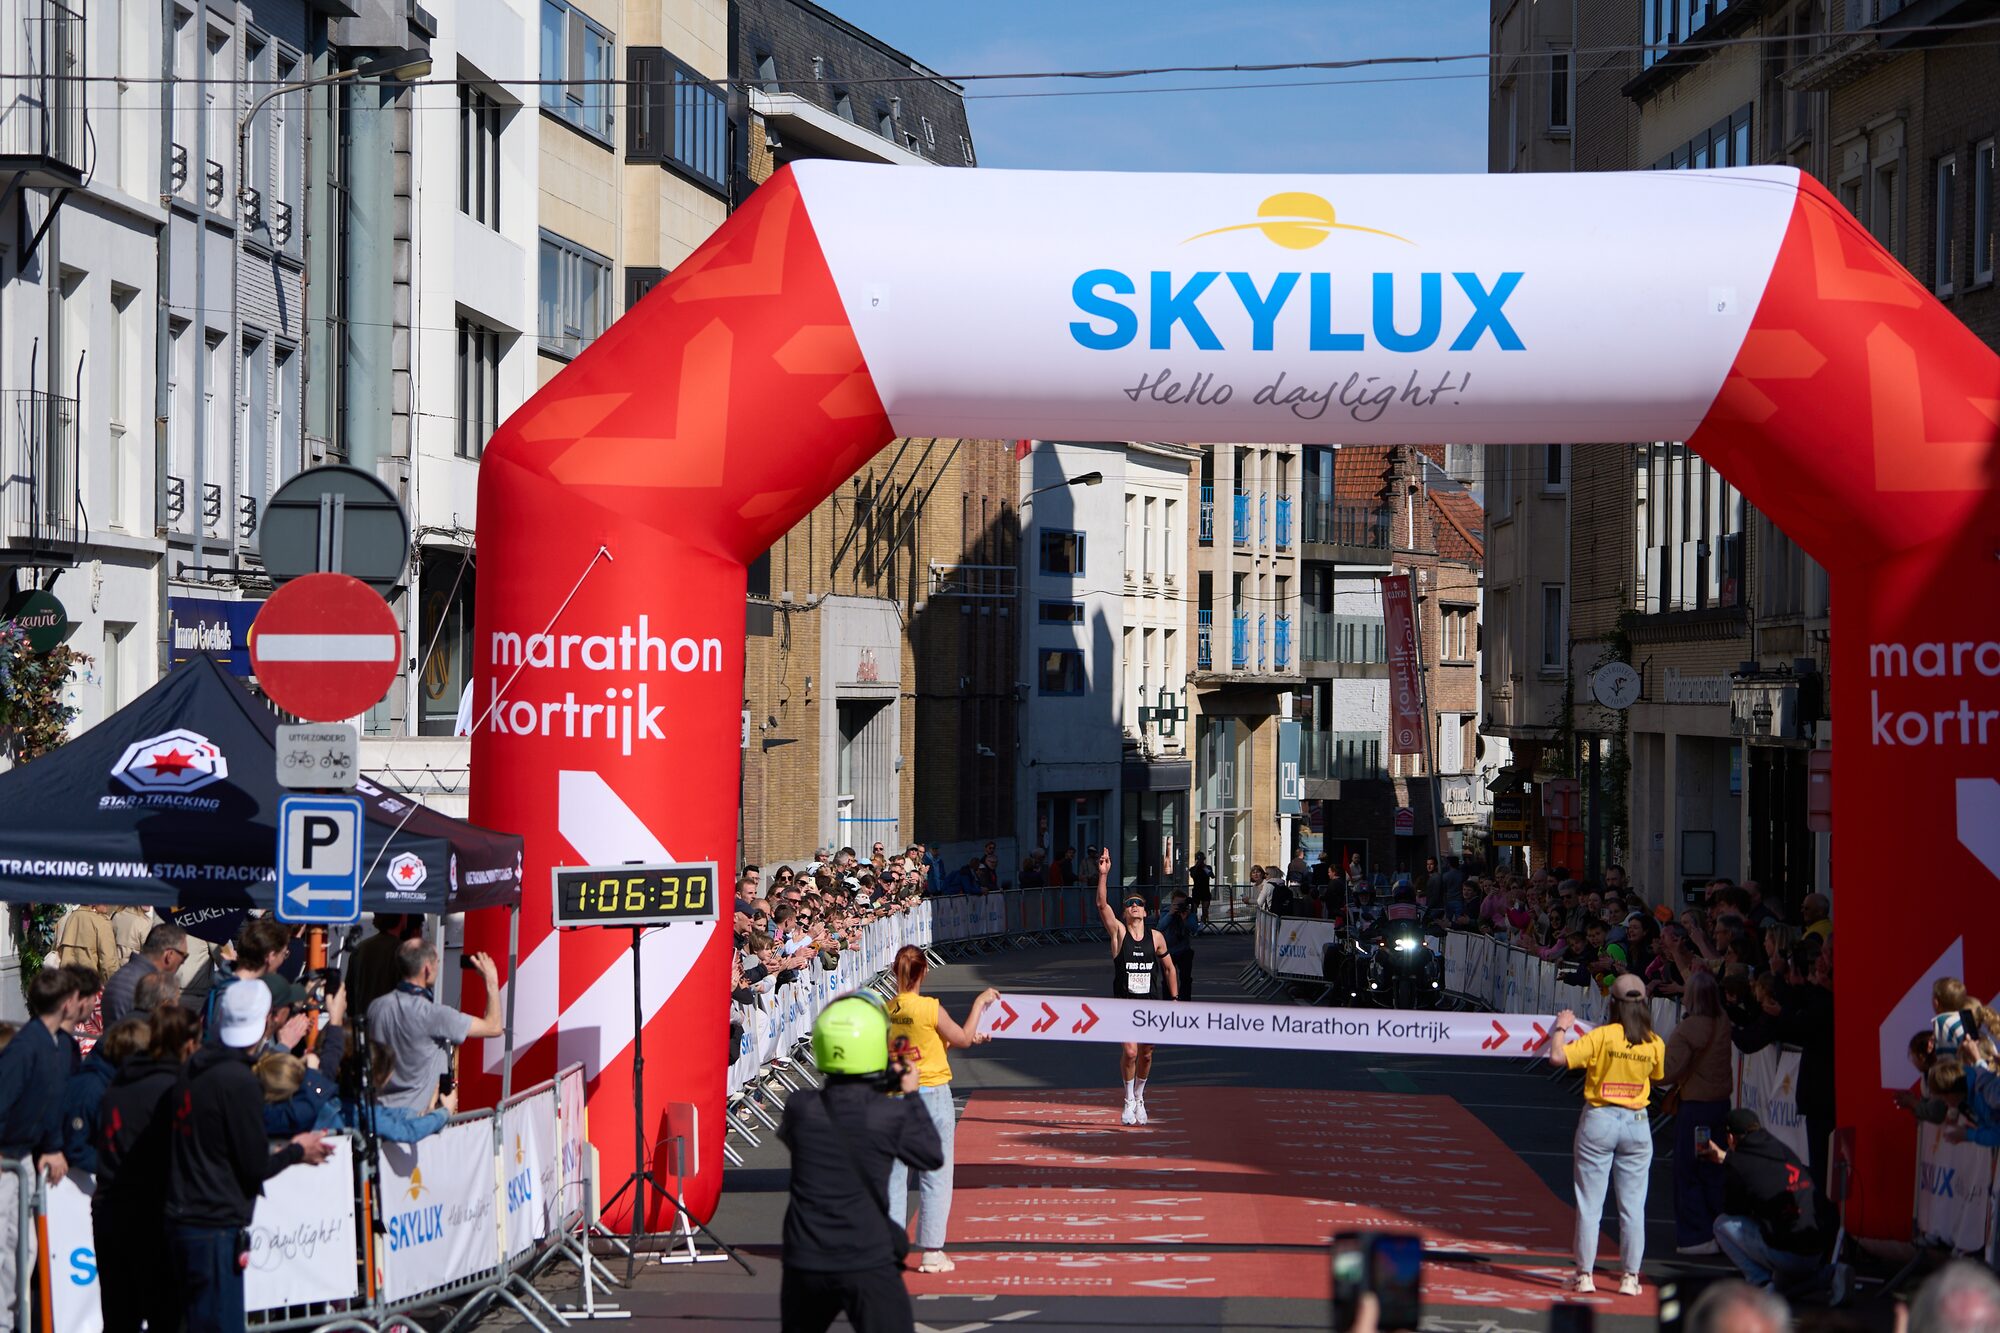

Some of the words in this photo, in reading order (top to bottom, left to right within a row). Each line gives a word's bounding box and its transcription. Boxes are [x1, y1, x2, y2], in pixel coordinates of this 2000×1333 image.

[1069, 269, 1527, 353] SKYLUX
[1124, 368, 1233, 406] Hello
[1253, 369, 1471, 422] daylight!
[174, 619, 197, 650] Immo
[199, 620, 231, 651] Goethals
[492, 614, 722, 672] marathon
[288, 733, 347, 743] UITGEZONDERD
[490, 677, 666, 756] kortrijk
[1871, 689, 2000, 746] kortr
[302, 815, 340, 869] P
[0, 859, 94, 877] TRACKING:
[578, 875, 708, 912] 1:06:30
[1279, 944, 1307, 959] SKYLUX
[1132, 1009, 1200, 1032] Skylux
[1207, 1012, 1264, 1032] Halve
[1272, 1015, 1369, 1037] Marathon
[1377, 1019, 1451, 1043] Kortrijk
[389, 1203, 443, 1251] SKYLUX
